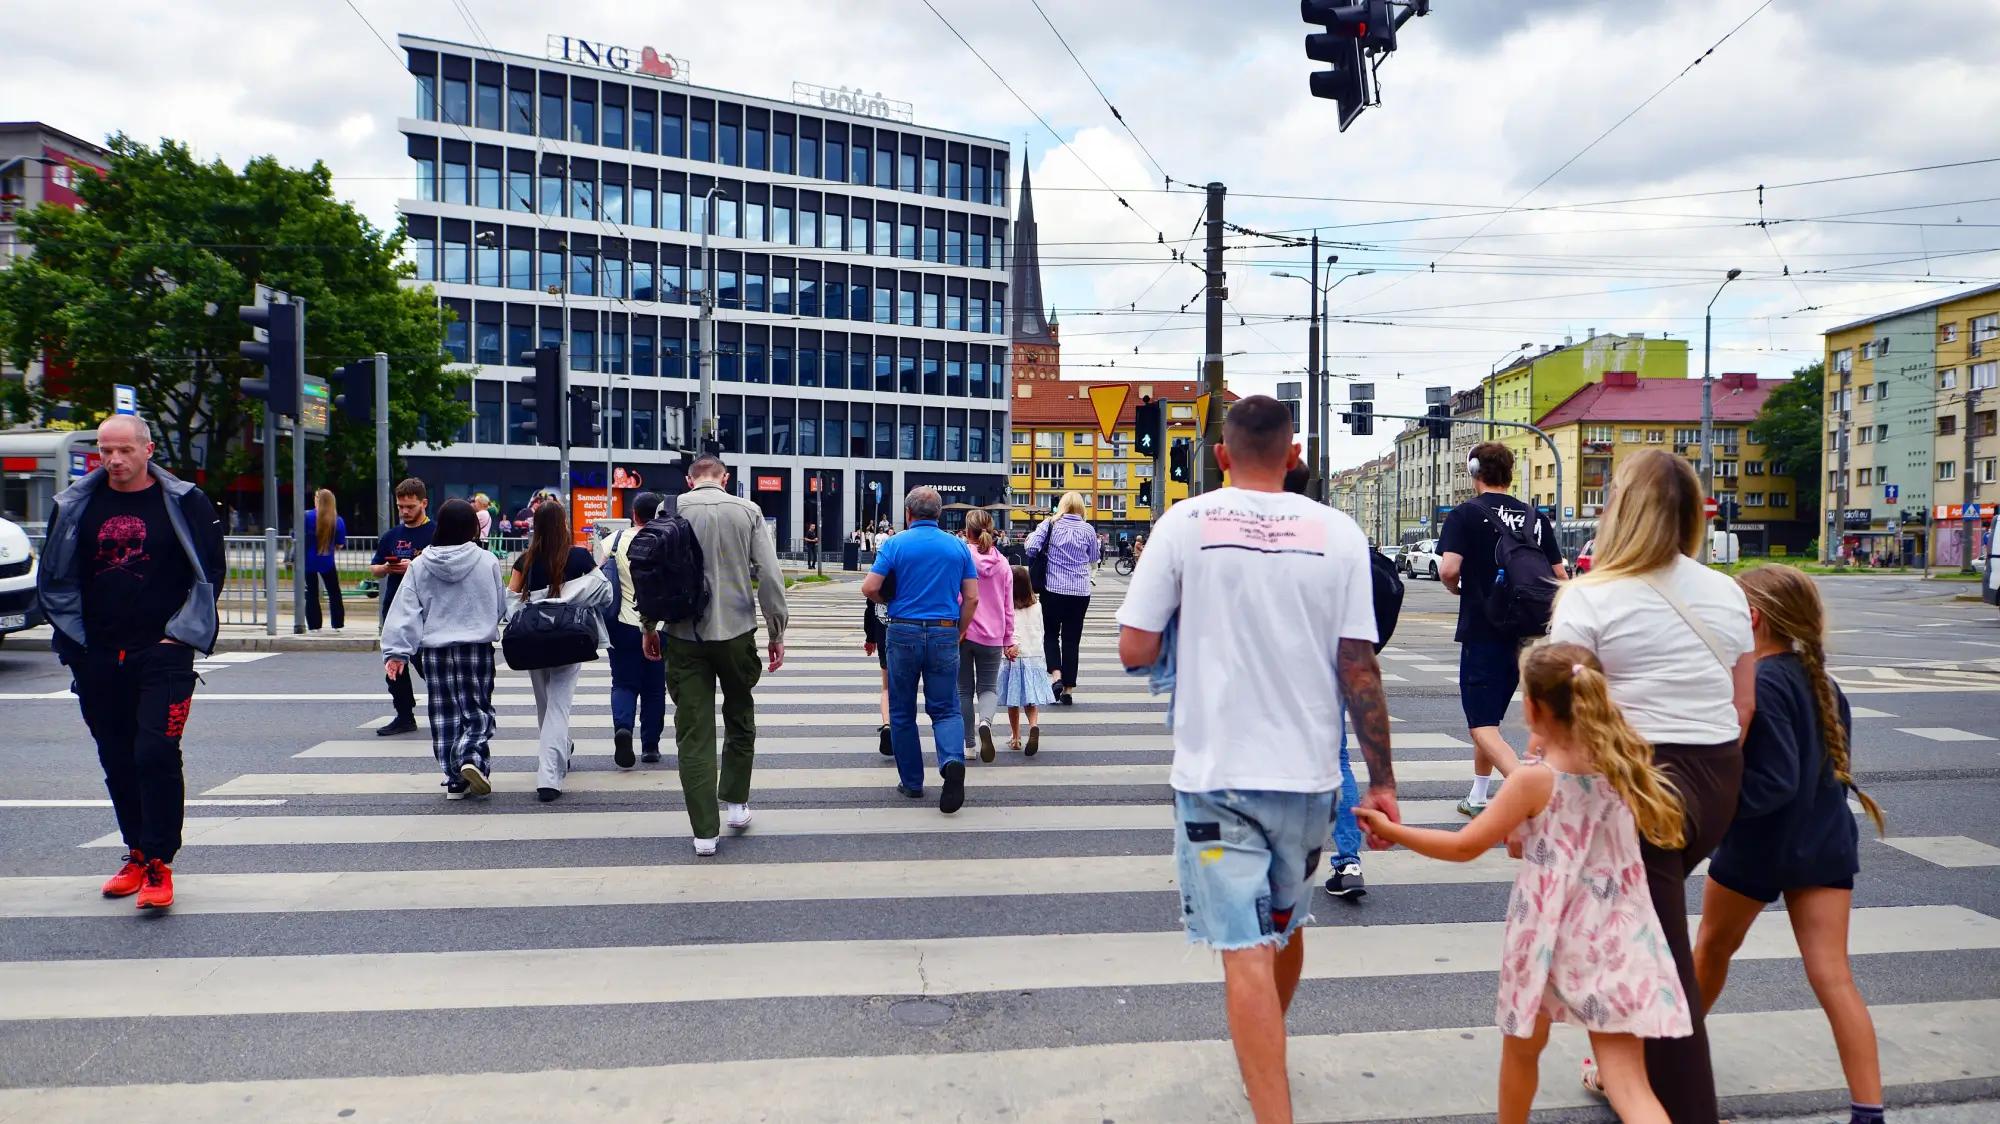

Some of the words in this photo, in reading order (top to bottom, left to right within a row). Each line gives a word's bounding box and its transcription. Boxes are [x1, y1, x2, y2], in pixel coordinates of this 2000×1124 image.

[560, 36, 629, 70] ING
[1205, 506, 1224, 517] GOT
[1229, 509, 1246, 517] ALL
